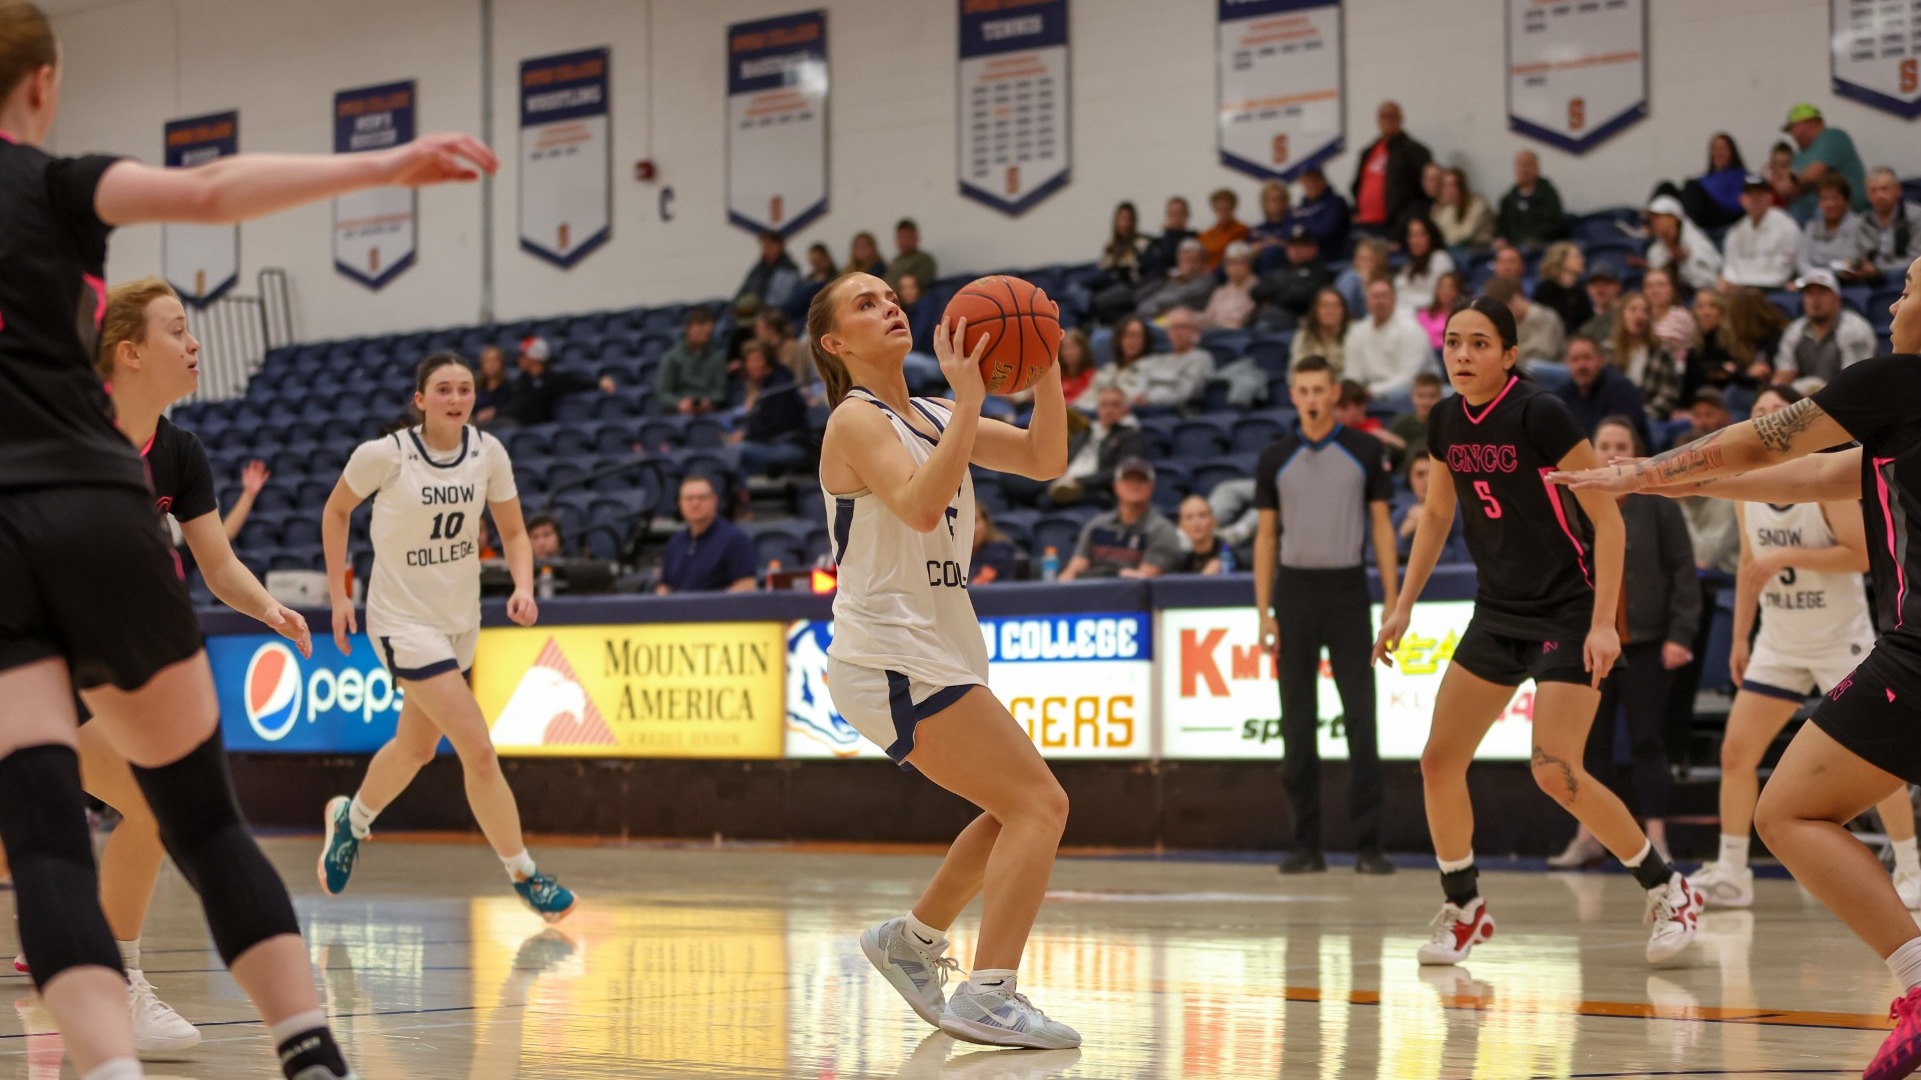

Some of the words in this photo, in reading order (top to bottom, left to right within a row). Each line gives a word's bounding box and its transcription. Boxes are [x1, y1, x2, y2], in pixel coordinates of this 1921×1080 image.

[1899, 58, 1918, 95] S
[1568, 98, 1586, 132] S
[1447, 444, 1518, 473] CNCC
[421, 484, 475, 505] SNOW
[1473, 480, 1502, 519] 5
[429, 511, 464, 540] 10
[1758, 526, 1802, 546] SNOW
[1001, 618, 1139, 660] COLLEGE
[604, 639, 770, 677] MOUNTAIN
[617, 683, 755, 721] AMERICA
